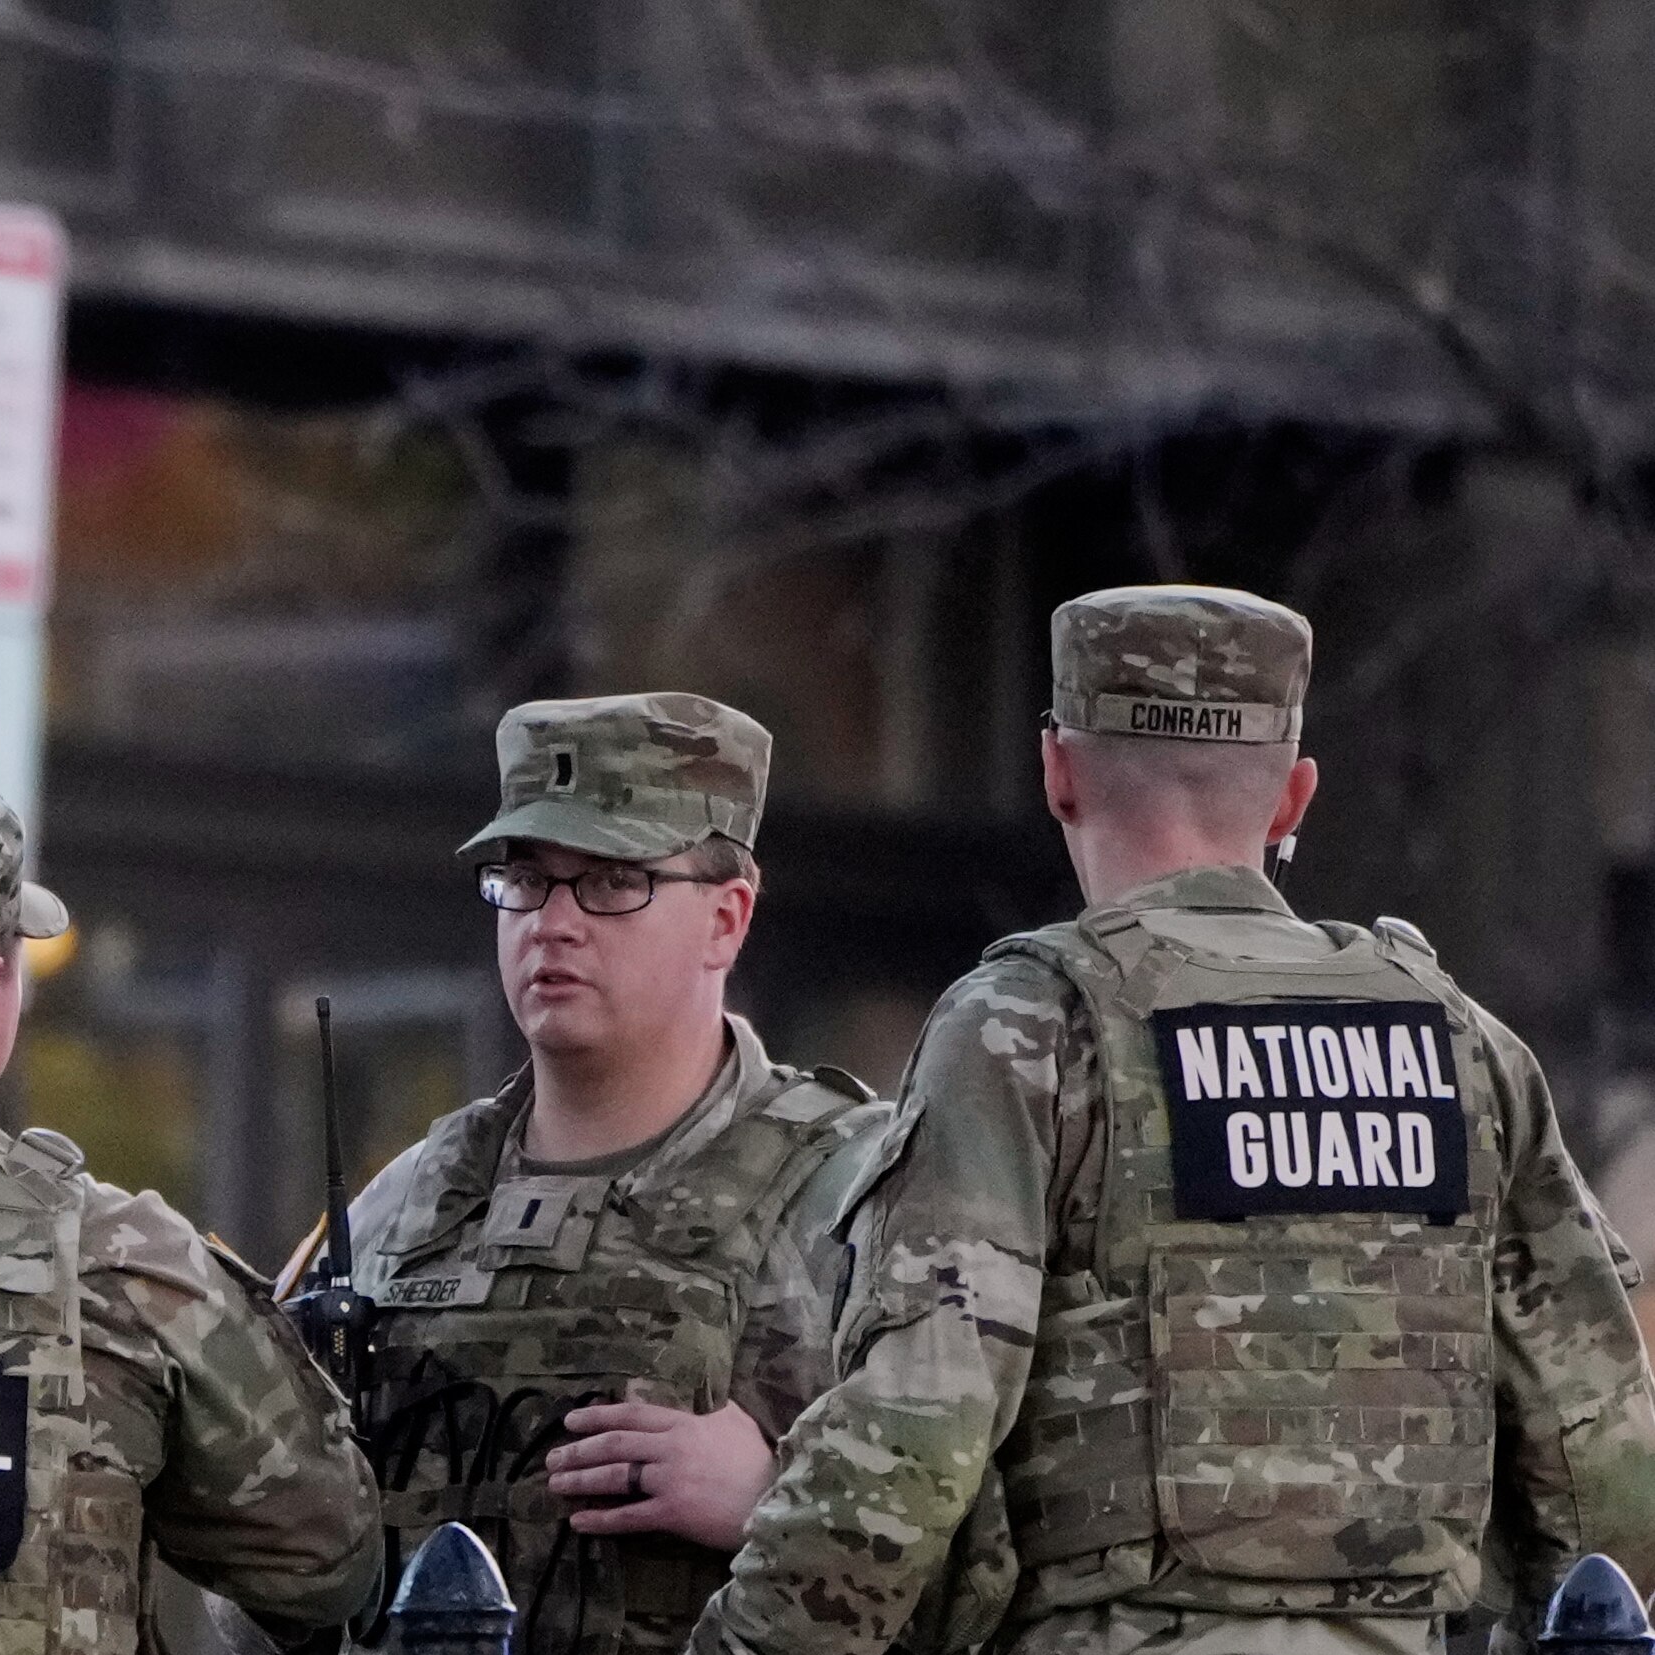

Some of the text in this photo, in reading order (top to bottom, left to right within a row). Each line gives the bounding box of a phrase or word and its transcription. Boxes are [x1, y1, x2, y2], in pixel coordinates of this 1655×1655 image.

[1129, 702, 1242, 738] CONRATH
[1175, 1023, 1457, 1101] NATIONAL
[1225, 1110, 1437, 1189] GUARD
